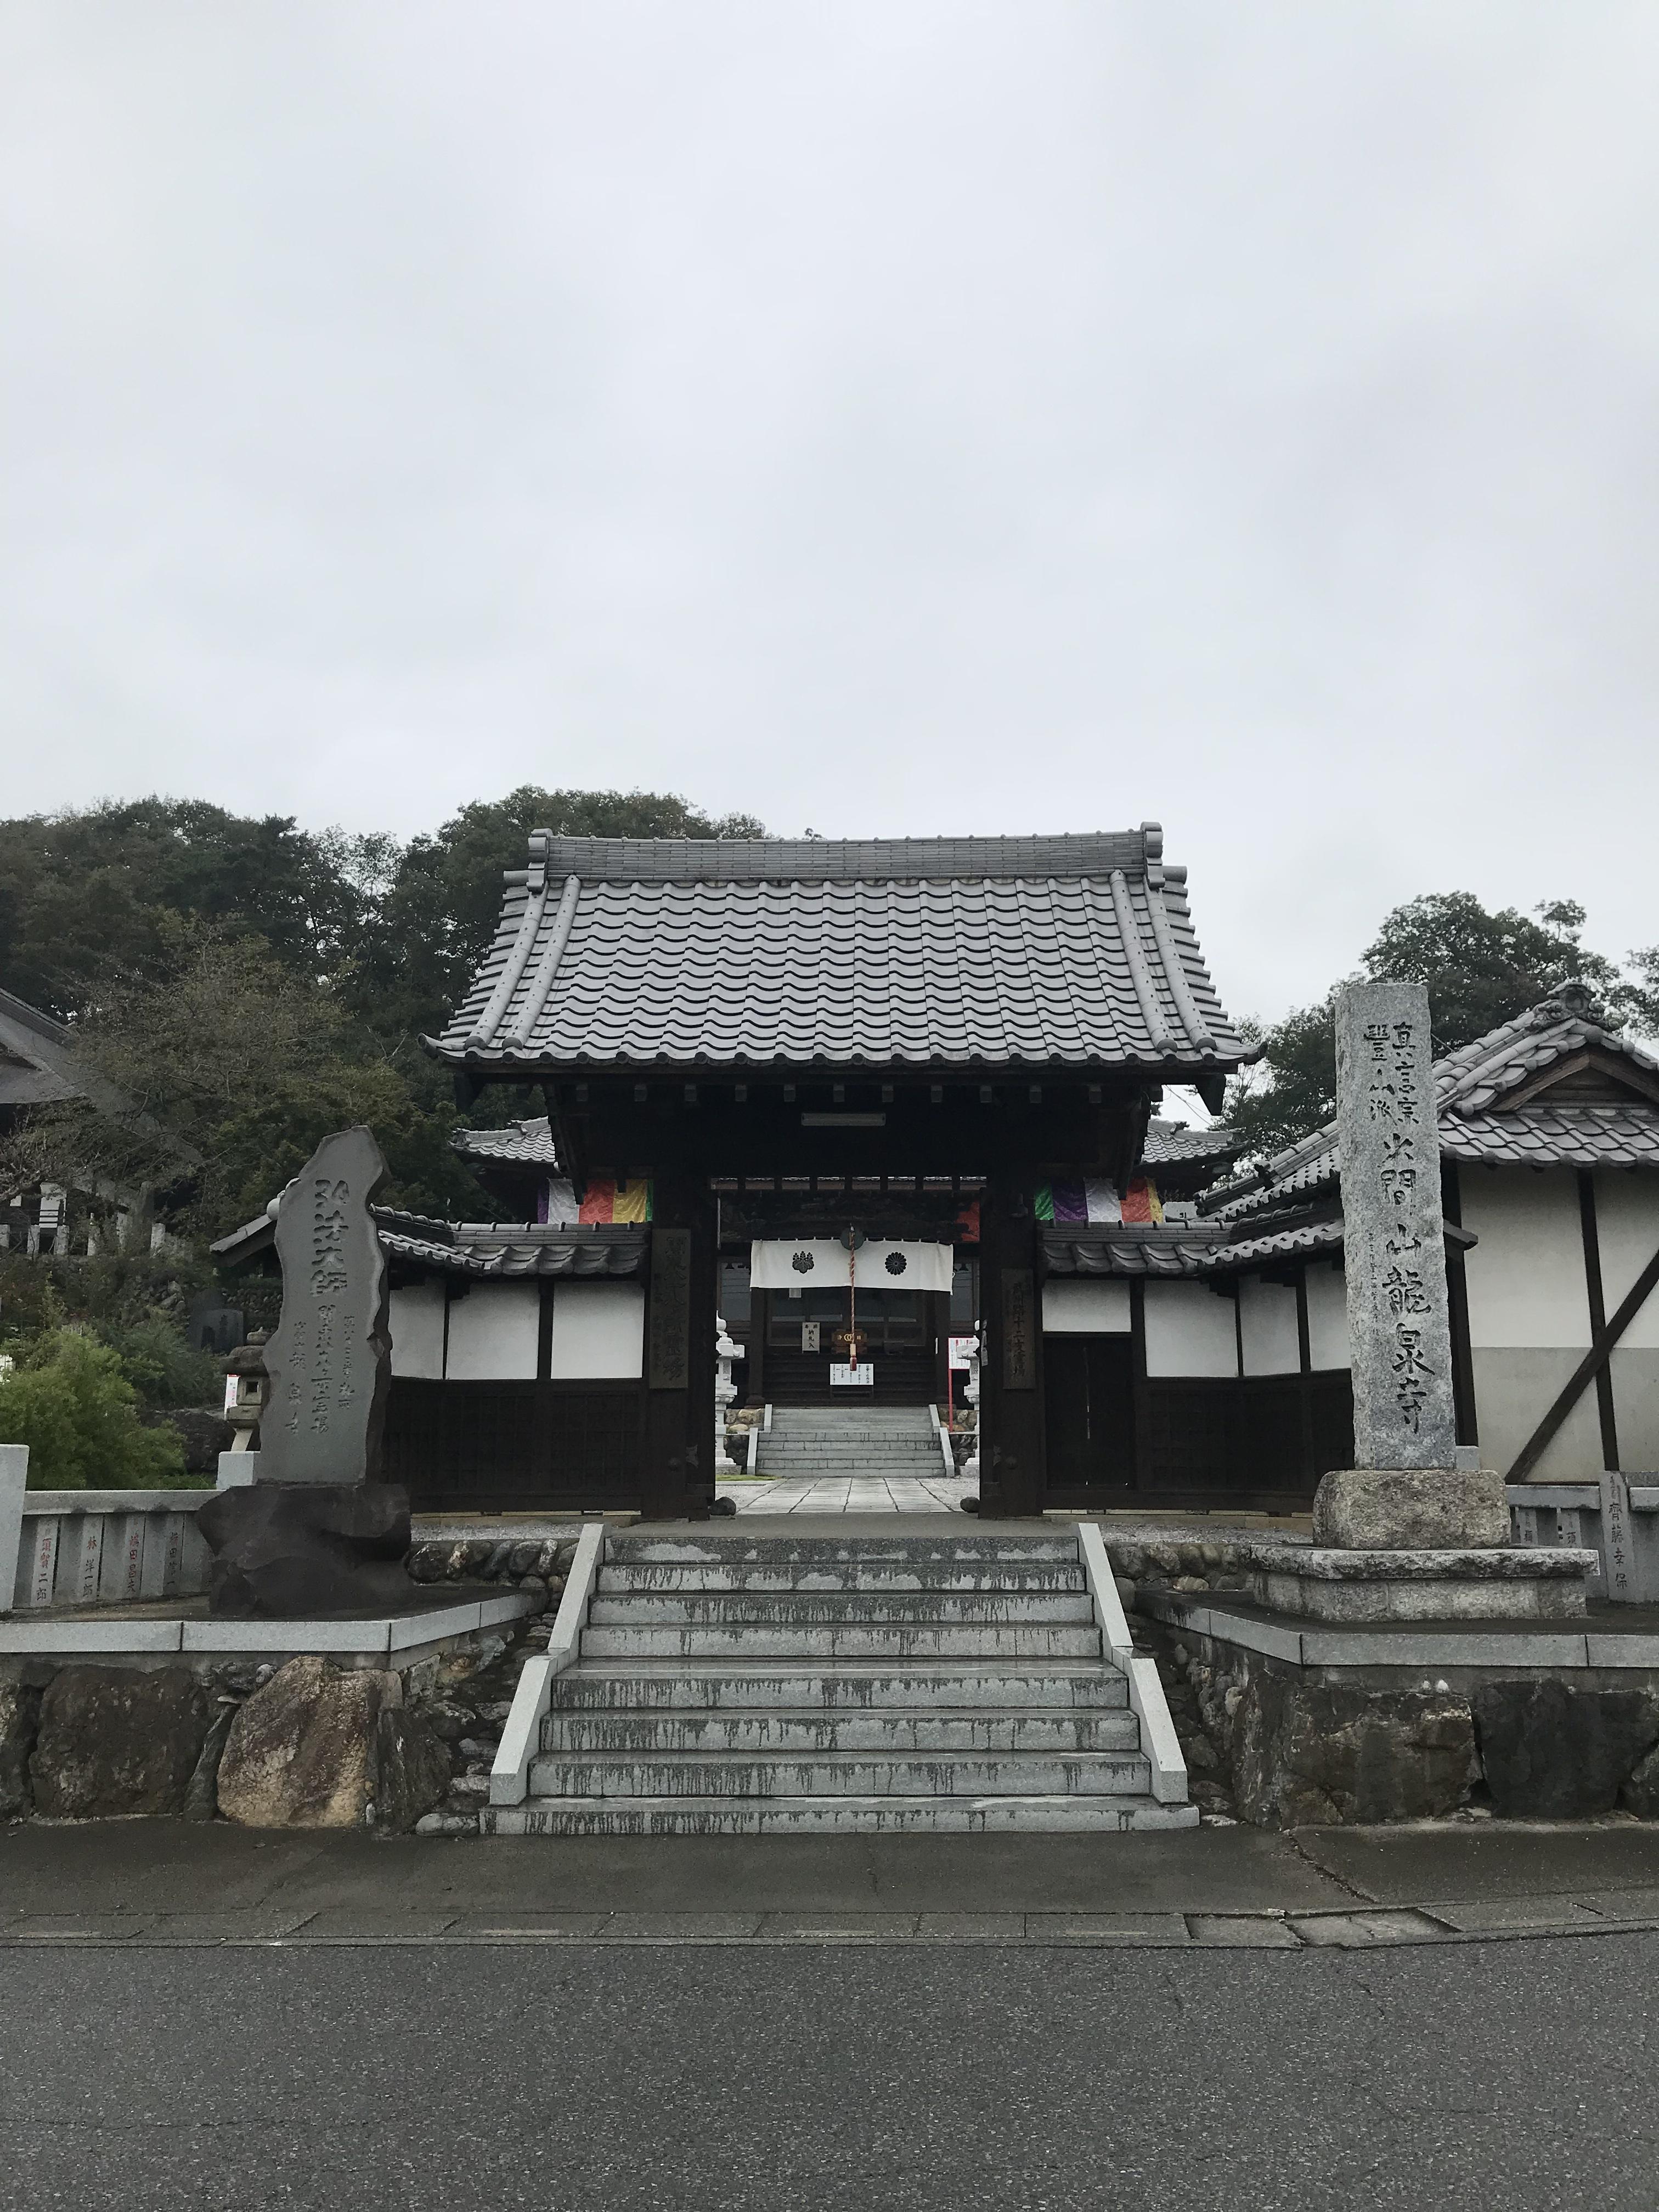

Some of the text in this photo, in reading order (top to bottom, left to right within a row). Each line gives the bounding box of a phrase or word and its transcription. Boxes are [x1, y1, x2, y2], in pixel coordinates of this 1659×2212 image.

[1392, 1022, 1419, 1124] 真言宗
[310, 1179, 350, 1298] 弘法大師
